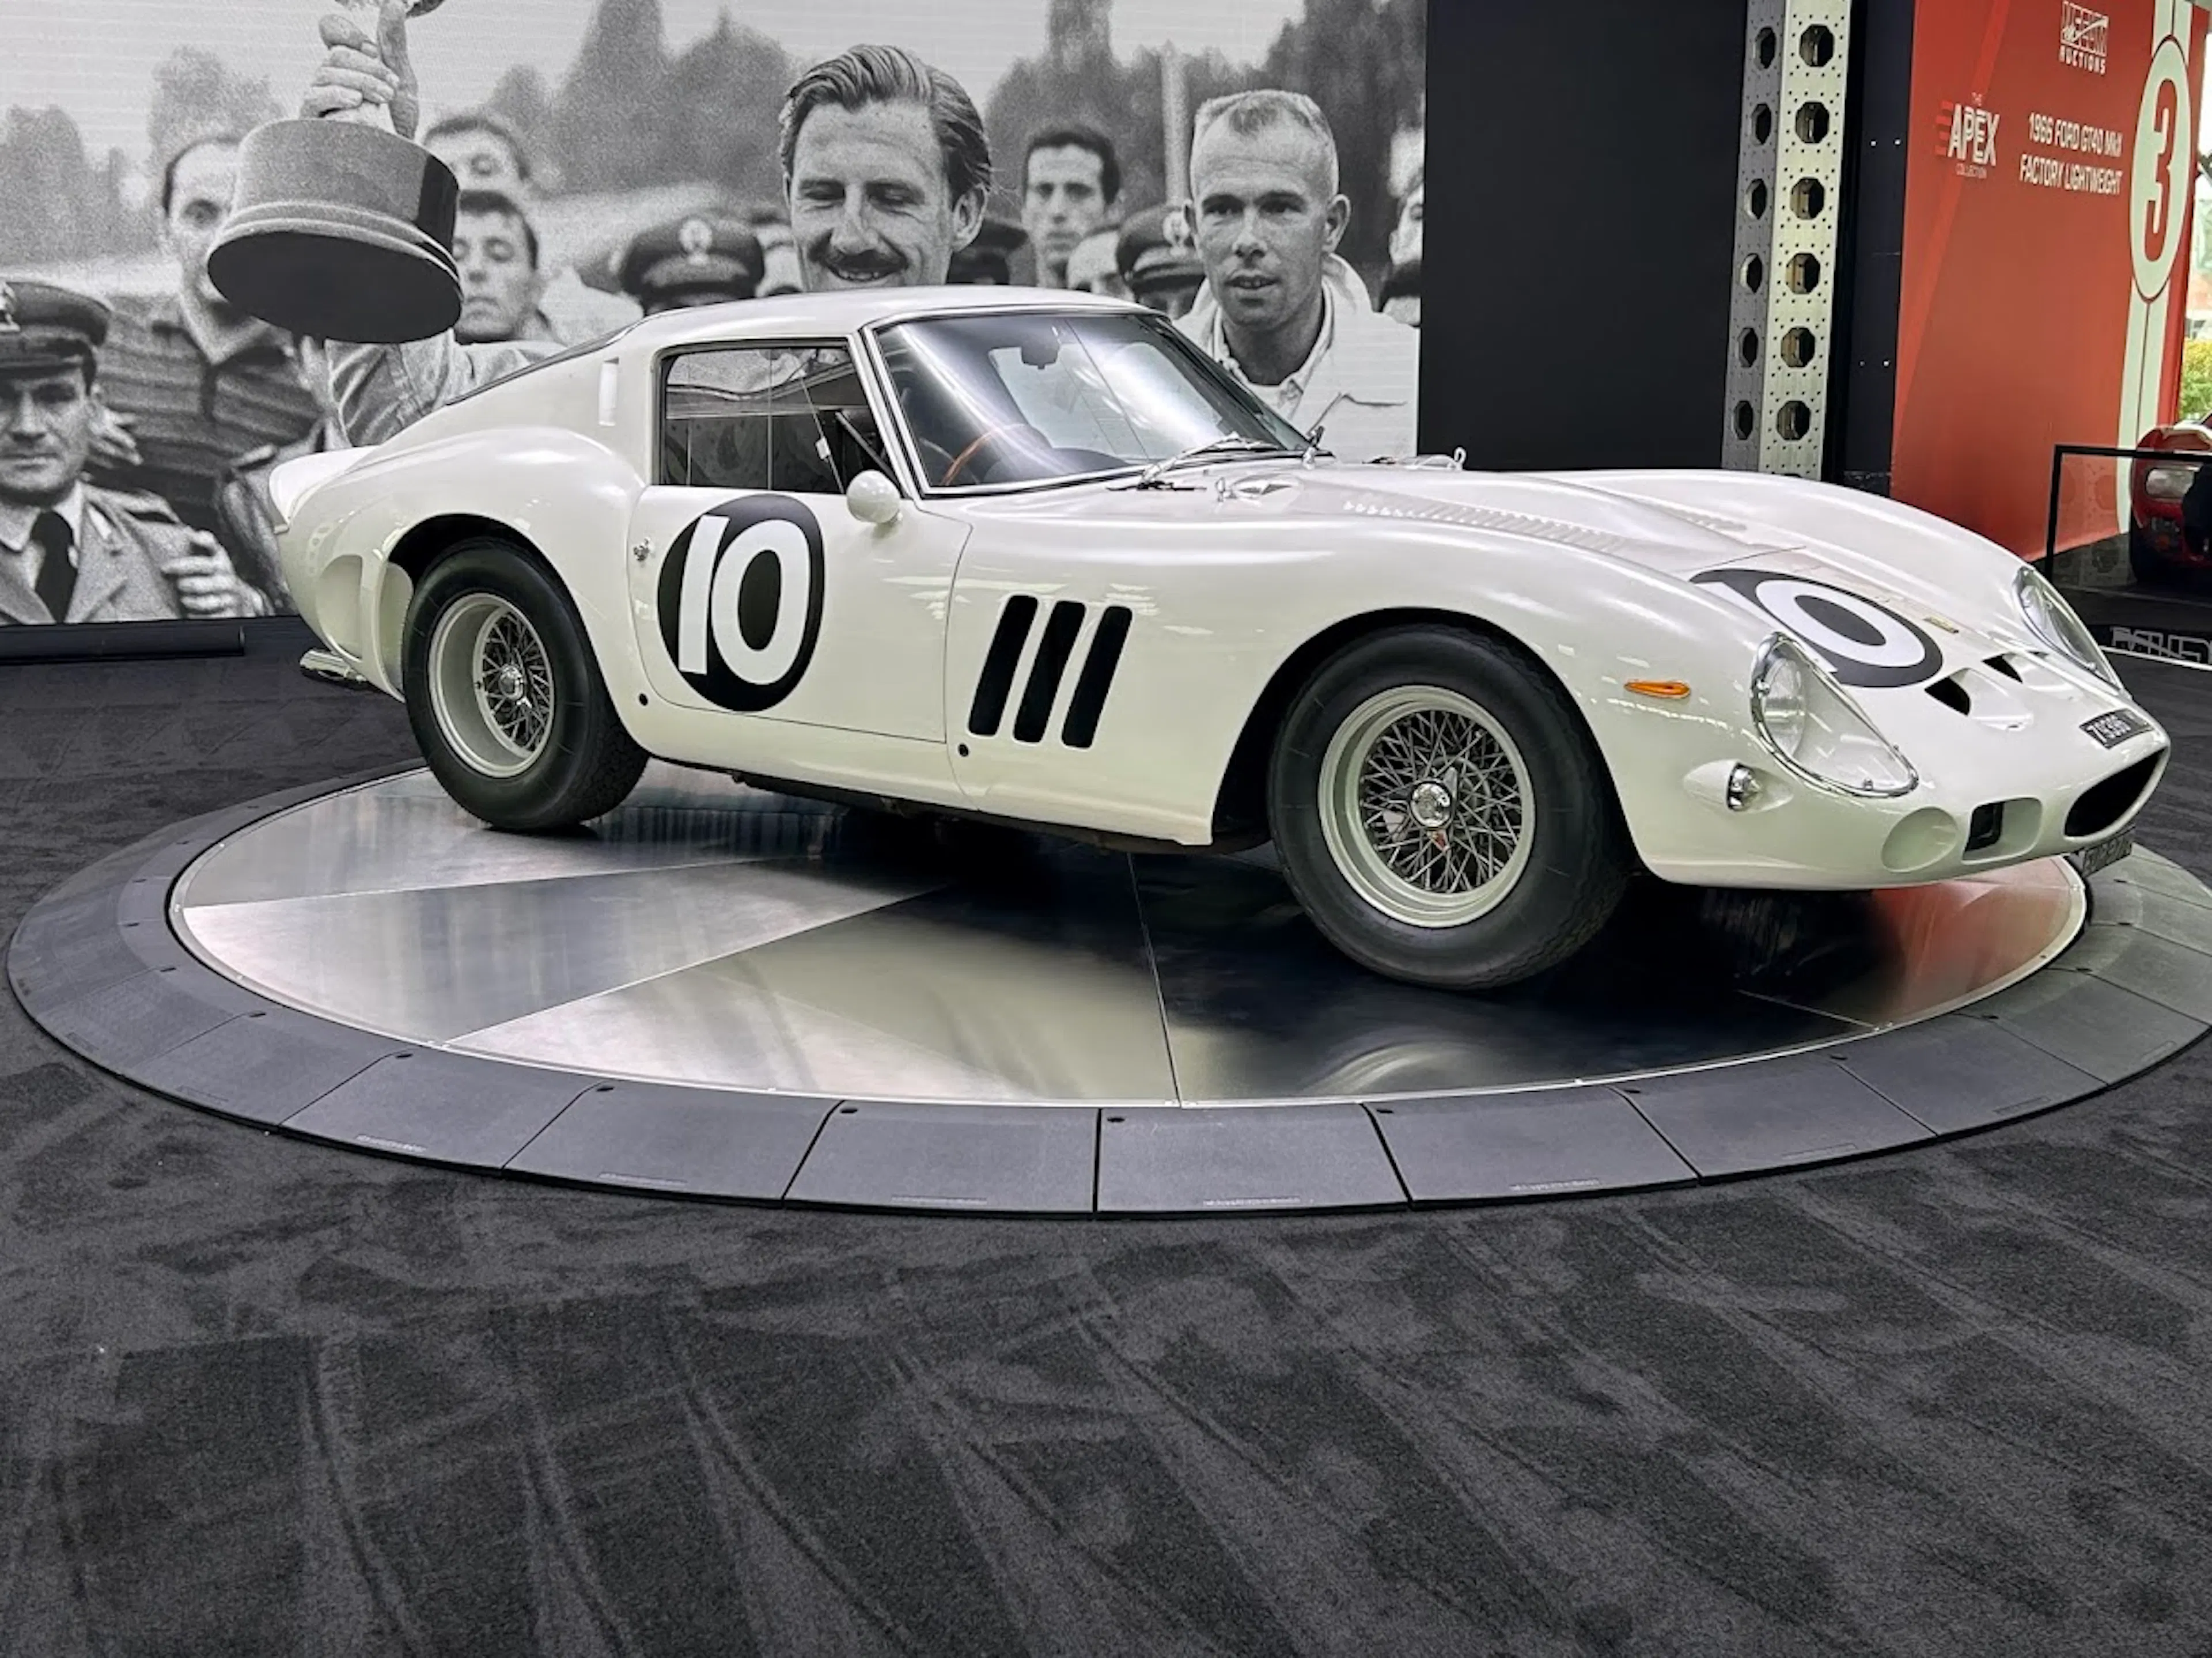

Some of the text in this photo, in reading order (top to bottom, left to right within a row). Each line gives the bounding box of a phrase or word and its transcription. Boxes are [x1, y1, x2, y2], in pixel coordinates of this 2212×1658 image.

[2059, 45, 2106, 74] AUCTIONS
[1947, 103, 2000, 166] APEX
[2055, 119, 2081, 150] FORD
[2081, 124, 2104, 155] GT40
[2020, 153, 2123, 195] FACTORY LIGHTWEIGHT
[2142, 78, 2179, 263] 3
[678, 514, 811, 686] 10
